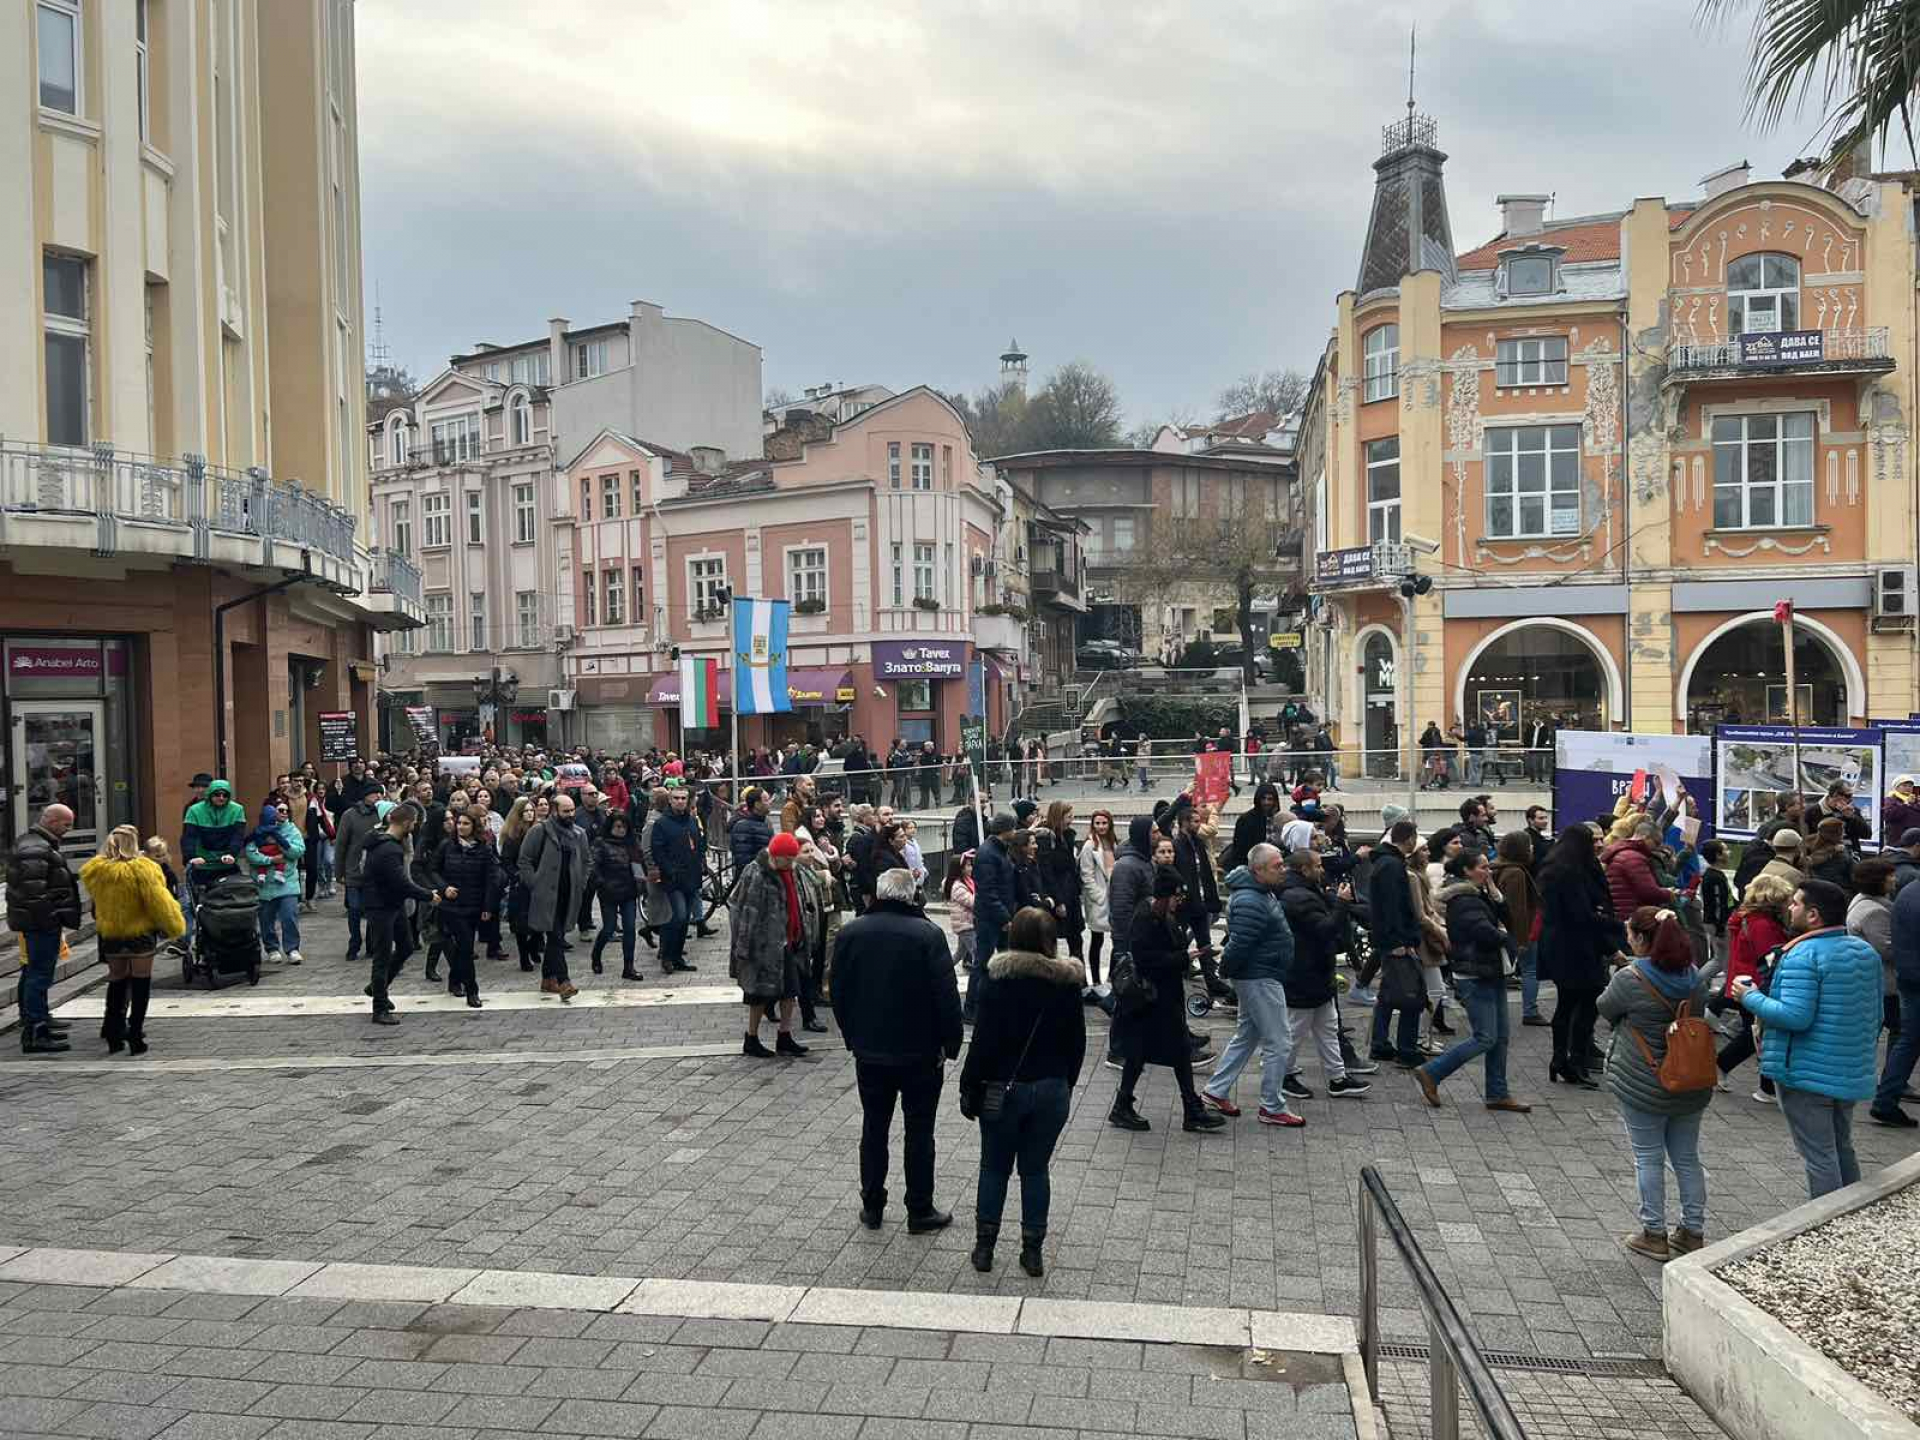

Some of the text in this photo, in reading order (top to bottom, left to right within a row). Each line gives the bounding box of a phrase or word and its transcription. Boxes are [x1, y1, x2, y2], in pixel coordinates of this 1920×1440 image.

[1781, 335, 1820, 348] ДАВА СЕ
[918, 647, 950, 659] Tavex
[35, 657, 98, 668] Anabel Arto
